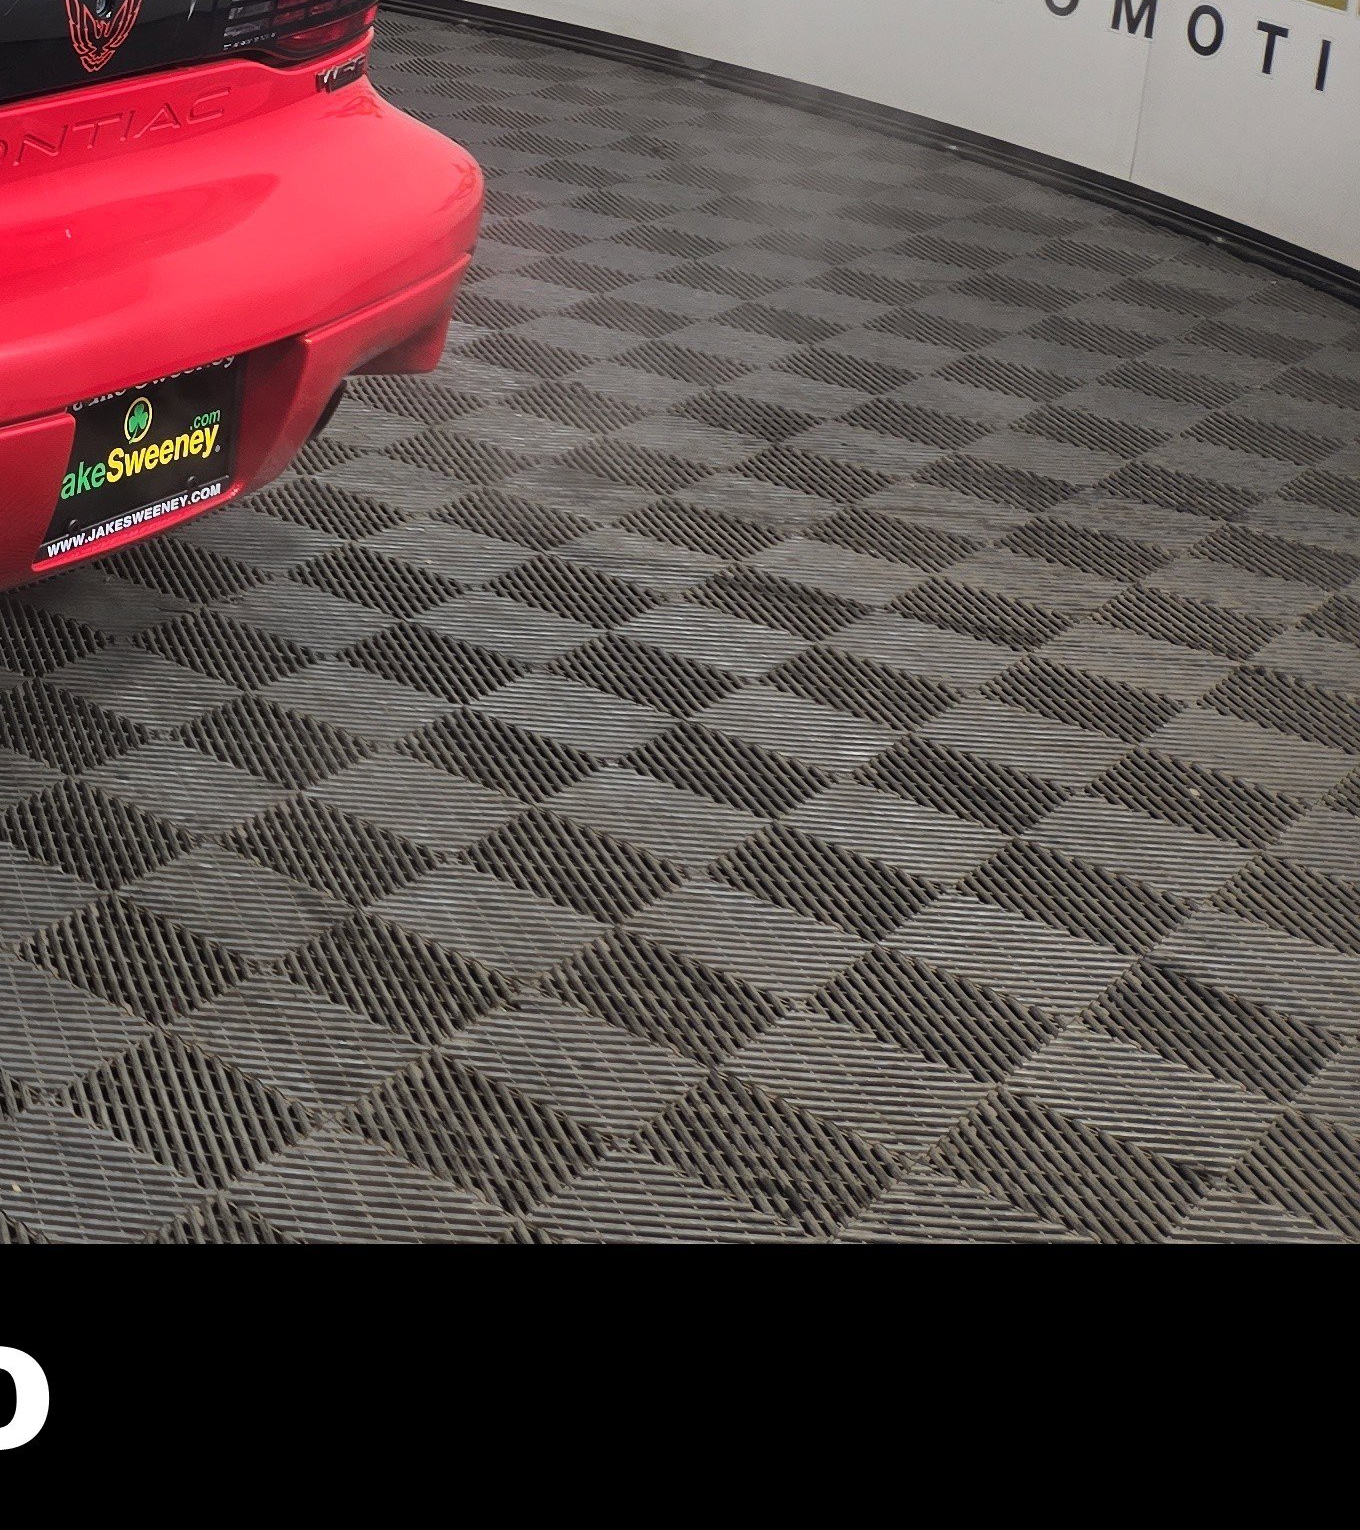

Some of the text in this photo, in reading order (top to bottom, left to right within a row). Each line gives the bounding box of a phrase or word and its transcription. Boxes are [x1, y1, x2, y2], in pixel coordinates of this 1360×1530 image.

[189, 408, 222, 431] .com
[59, 423, 220, 500] akeSweeney
[46, 482, 222, 558] WWW.JAKESWEENEY.COM
